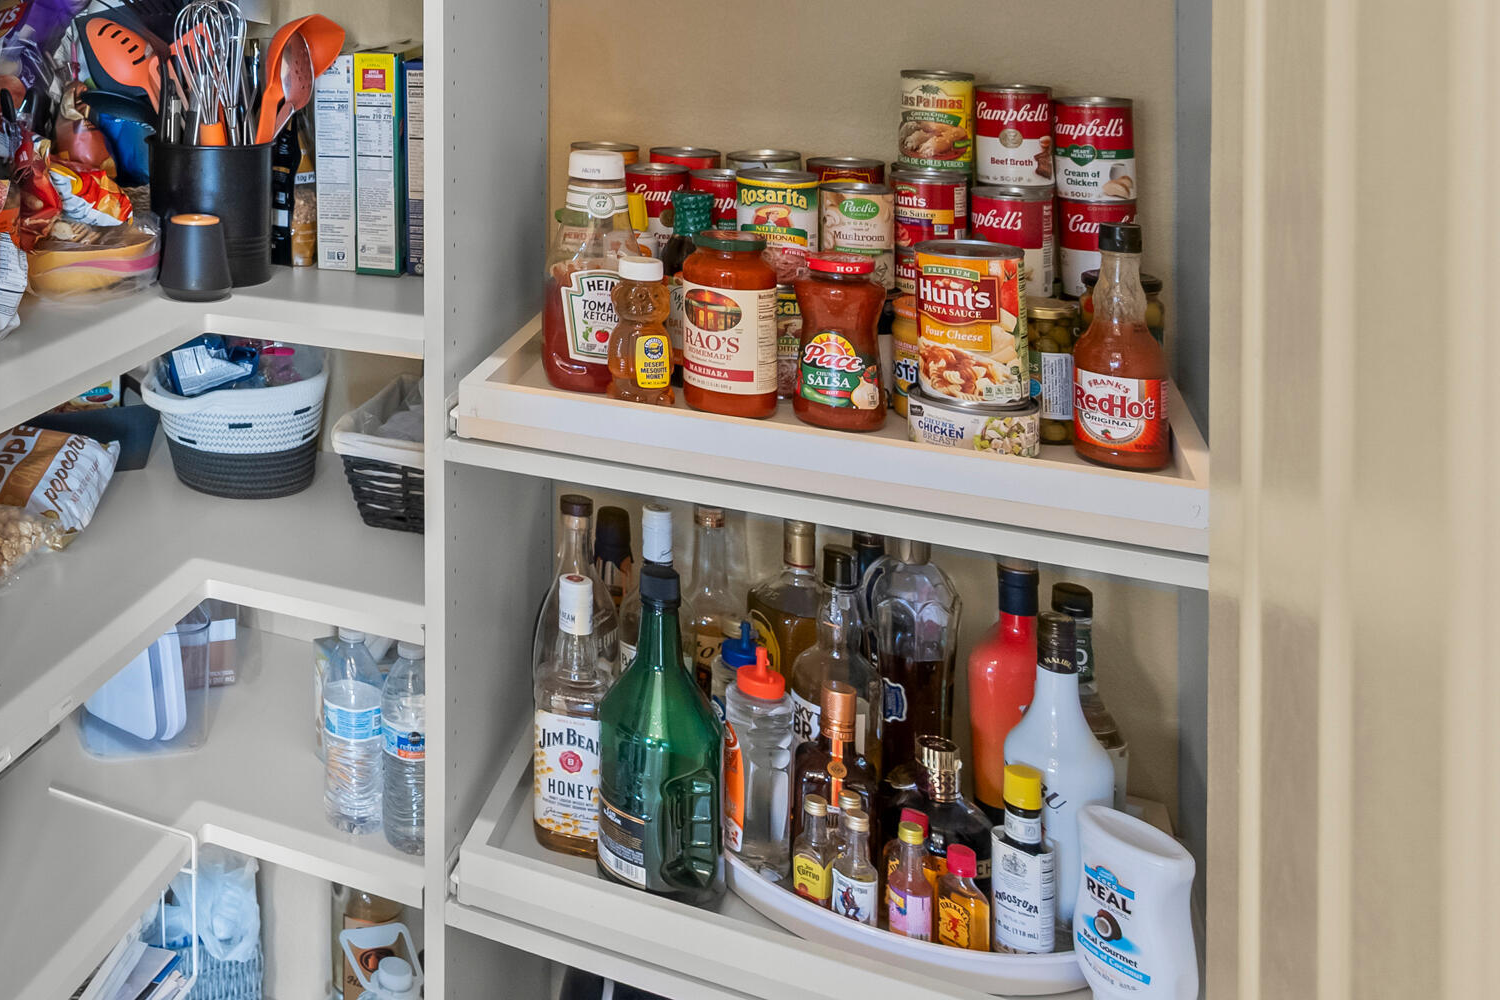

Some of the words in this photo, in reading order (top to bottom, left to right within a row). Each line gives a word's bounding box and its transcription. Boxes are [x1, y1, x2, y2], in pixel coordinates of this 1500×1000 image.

[337, 103, 349, 111] 260
[976, 101, 1049, 123] Campbell's
[929, 111, 948, 119] CHILE
[911, 158, 919, 166] DE
[920, 158, 941, 167] CHILES
[942, 159, 964, 168] VERDES
[990, 157, 1009, 166] Beef
[1009, 158, 1033, 167] Broth
[1071, 152, 1094, 160] HEALTHY
[1064, 168, 1087, 178] Cream
[1090, 169, 1100, 178] of
[1066, 178, 1098, 188] Chicken
[596, 200, 607, 208] 57
[741, 188, 807, 210] Rosarita
[842, 200, 877, 214] Pacific
[912, 210, 936, 219] Sauce
[833, 230, 885, 242] Mushroom
[927, 266, 971, 278] PREMIUM
[919, 278, 990, 310] Hunt's
[924, 303, 949, 315] PASTA
[950, 307, 982, 319] SAUCE
[685, 326, 739, 354] RAO'S
[925, 325, 944, 337] Four
[946, 328, 983, 342] Cheese
[803, 343, 862, 372] Pace
[640, 366, 668, 374] MESQUITE
[689, 365, 729, 379] MARINARA
[807, 374, 850, 388] SALSA
[1087, 379, 1131, 394] FRANK'S
[1073, 383, 1155, 419] RedHot
[923, 416, 956, 428] CHUNK
[1083, 413, 1135, 428] ORIGINAL
[918, 420, 964, 438] CHICKEN
[922, 431, 958, 445] BREAST
[539, 729, 563, 748] JIM
[548, 778, 593, 800] HONEY
[1086, 876, 1132, 914] REAL
[1083, 928, 1098, 942] Real
[1099, 935, 1138, 969] Gourmet
